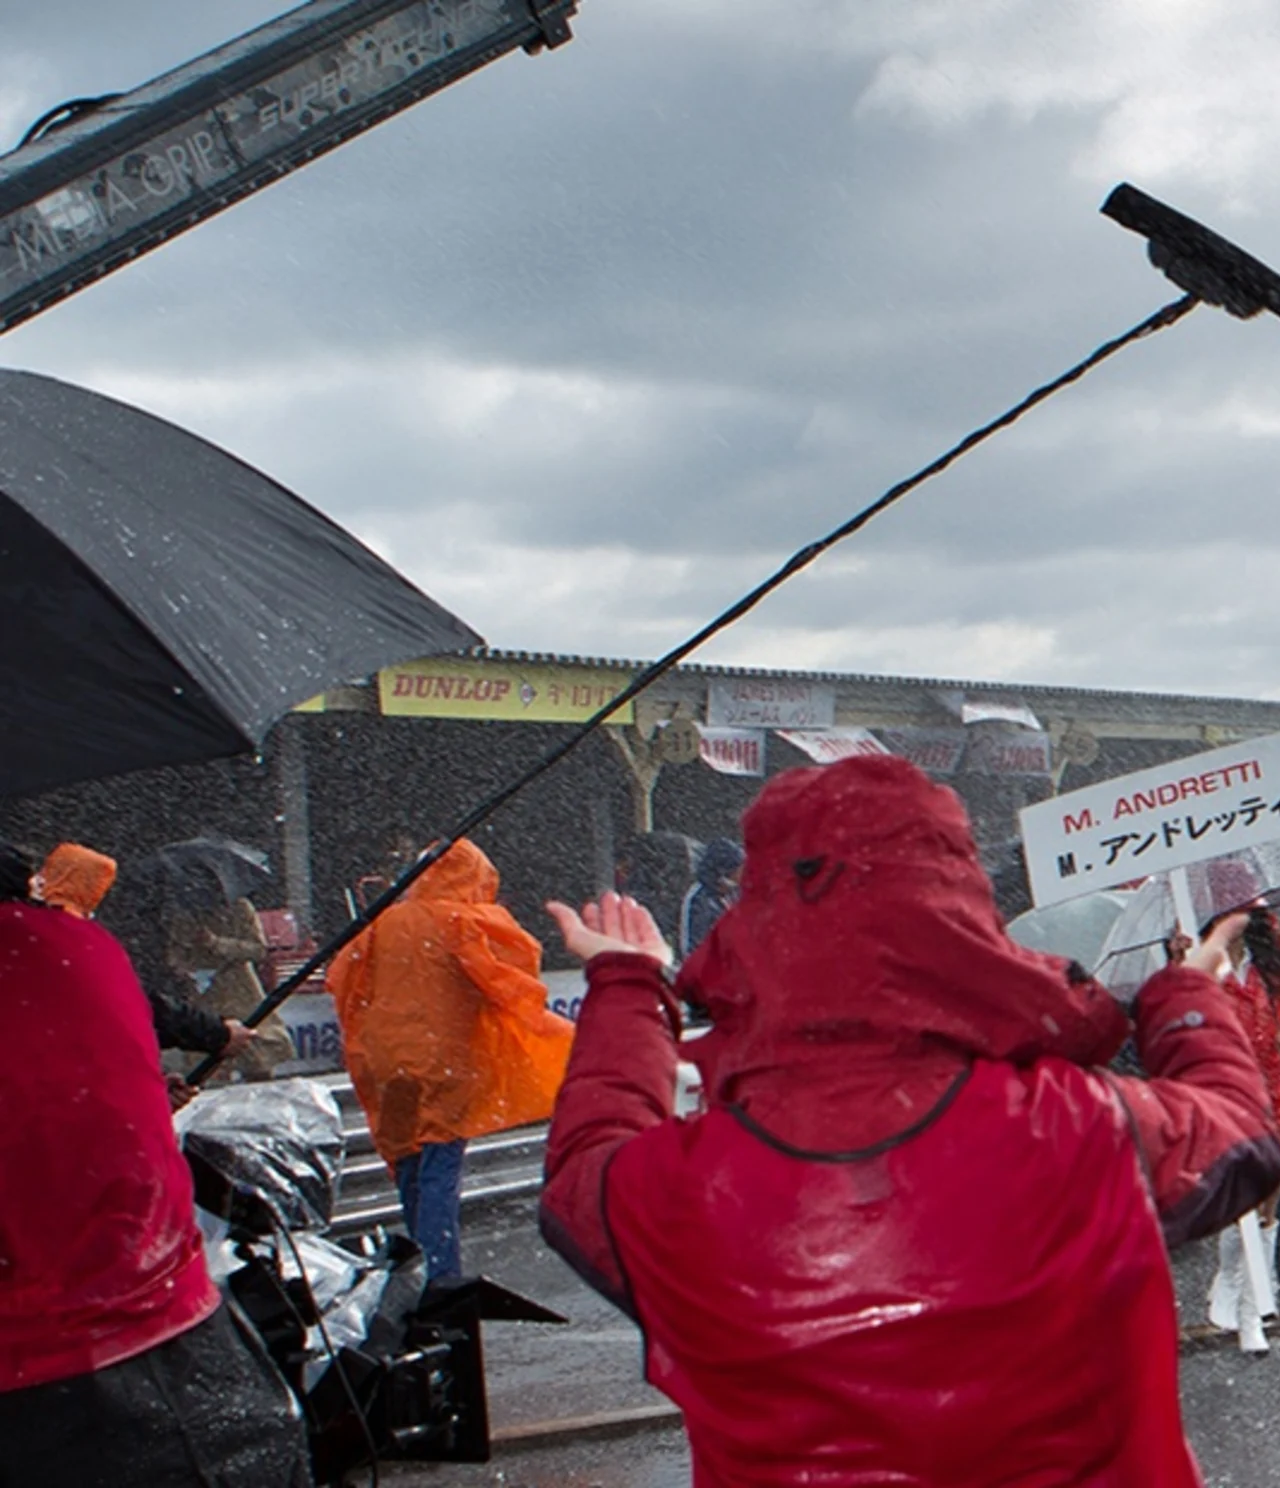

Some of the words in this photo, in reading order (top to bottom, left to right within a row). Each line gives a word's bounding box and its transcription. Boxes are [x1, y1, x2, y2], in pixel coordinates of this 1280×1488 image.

[391, 673, 512, 702] DUNLOP
[1061, 808, 1101, 835] M.
[1112, 759, 1262, 821] ANDRETTI
